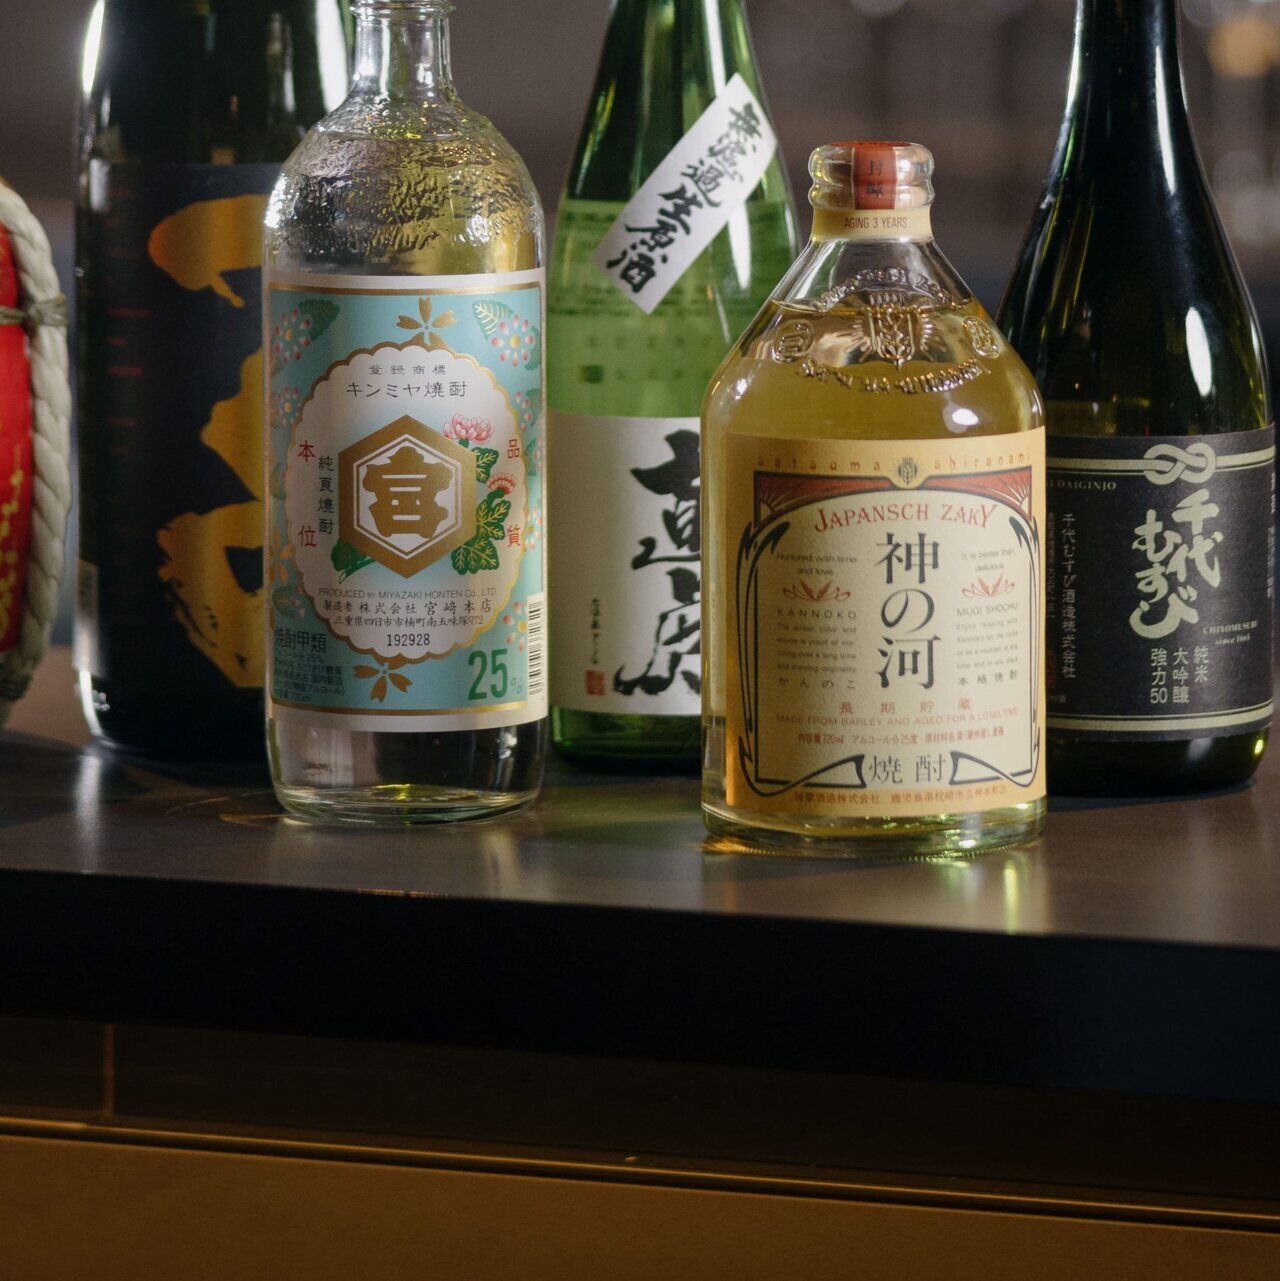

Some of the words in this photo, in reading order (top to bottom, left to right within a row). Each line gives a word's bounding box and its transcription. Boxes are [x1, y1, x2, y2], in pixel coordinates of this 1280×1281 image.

[844, 216, 869, 229] AGING
[872, 216, 879, 229] 3
[881, 216, 907, 229] YEARS
[814, 503, 929, 533] JAPANSCH
[941, 503, 998, 528] ZAKY
[319, 587, 365, 599] PRODUCED
[378, 590, 422, 599] MIYAZAKI
[425, 589, 463, 599] HONTEN
[777, 607, 857, 620] KANNOKO
[874, 531, 941, 690] 神の河
[985, 601, 1018, 615] SHOCHU
[386, 632, 431, 647] 192928
[1192, 646, 1210, 684] 純米
[776, 713, 802, 725] MADE
[807, 716, 837, 726] FROM
[841, 716, 883, 727] BARLEY
[887, 716, 911, 726] AND
[914, 715, 943, 725] AGED
[946, 714, 966, 724] FOR
[977, 710, 1002, 721] LONG
